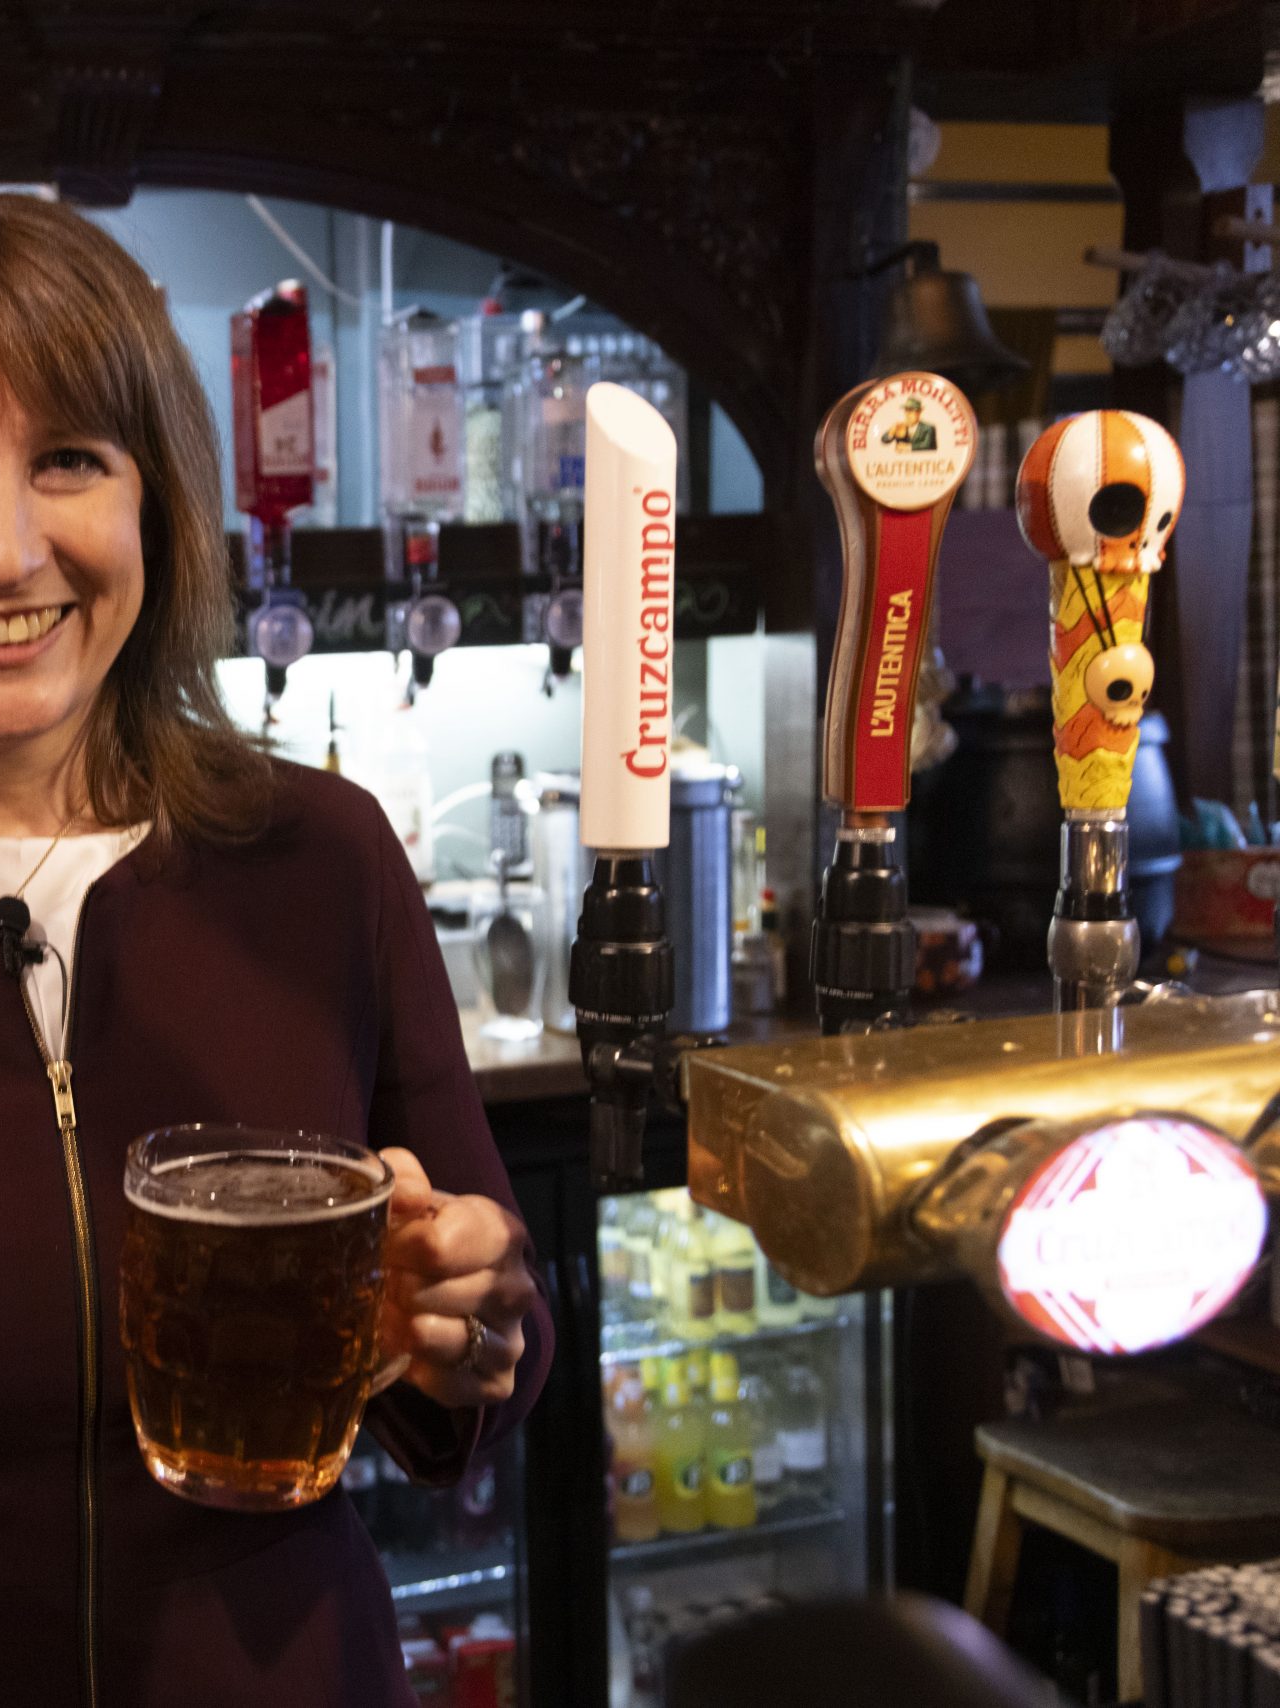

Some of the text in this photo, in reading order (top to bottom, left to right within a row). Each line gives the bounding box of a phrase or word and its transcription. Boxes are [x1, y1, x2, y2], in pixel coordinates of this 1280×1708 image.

[852, 379, 969, 451] BIRRA MORETTI
[865, 460, 956, 478] L'AUTENTICA
[621, 489, 675, 780] Cruzcampo
[870, 589, 914, 737] L'AUTENTICA
